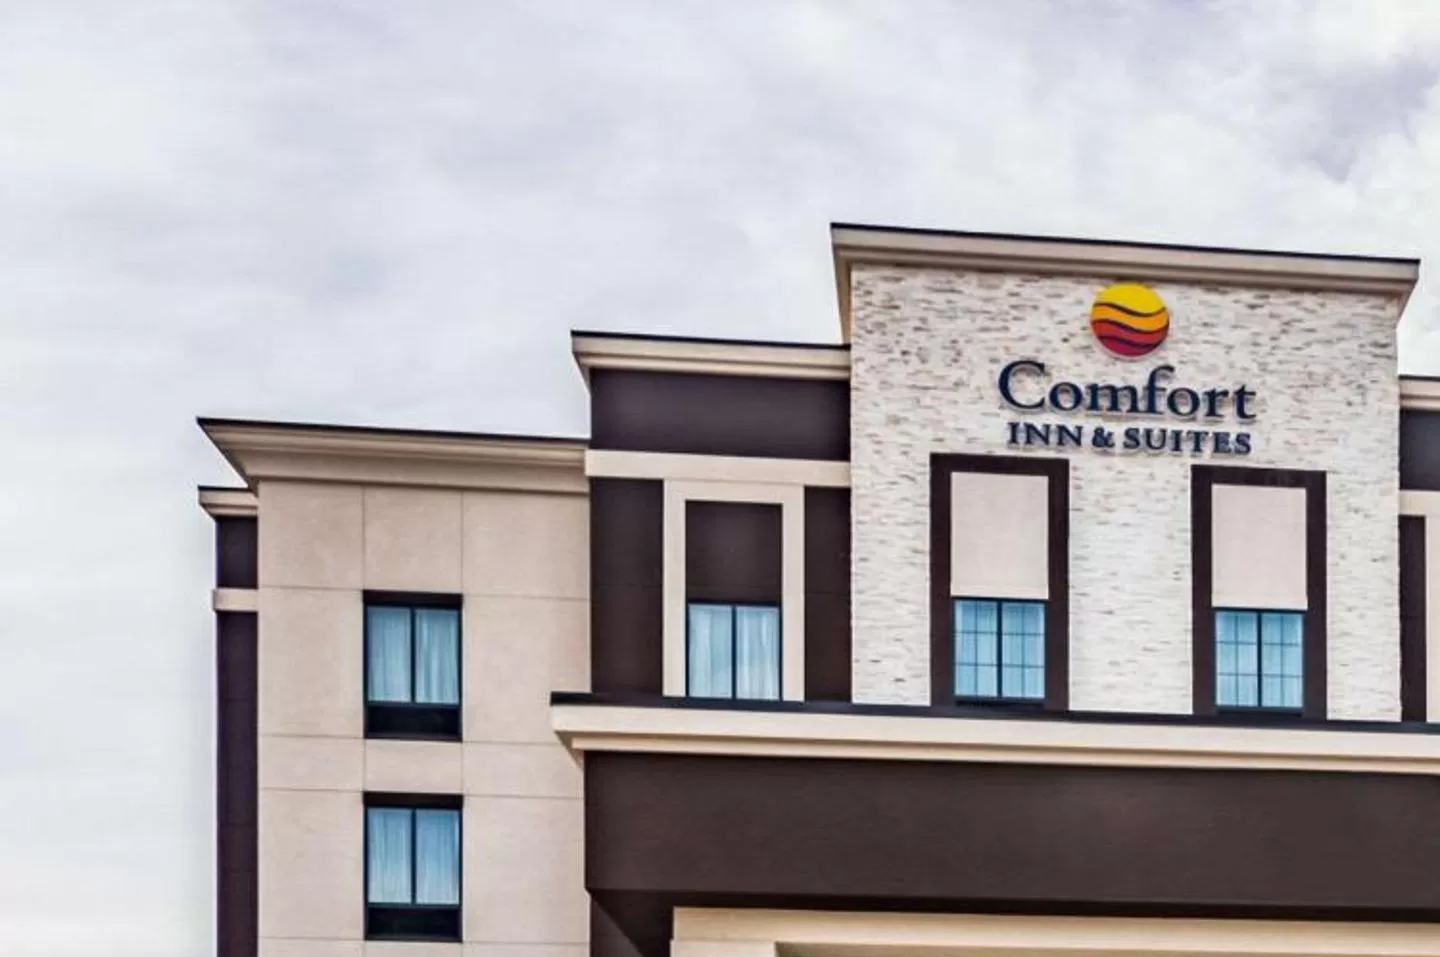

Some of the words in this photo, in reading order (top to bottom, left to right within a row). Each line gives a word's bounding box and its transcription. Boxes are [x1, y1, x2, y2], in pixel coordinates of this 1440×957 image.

[998, 360, 1257, 420] Comfort
[1008, 422, 1083, 446] INN
[1092, 427, 1116, 449] &
[1123, 428, 1252, 454] SUITES
